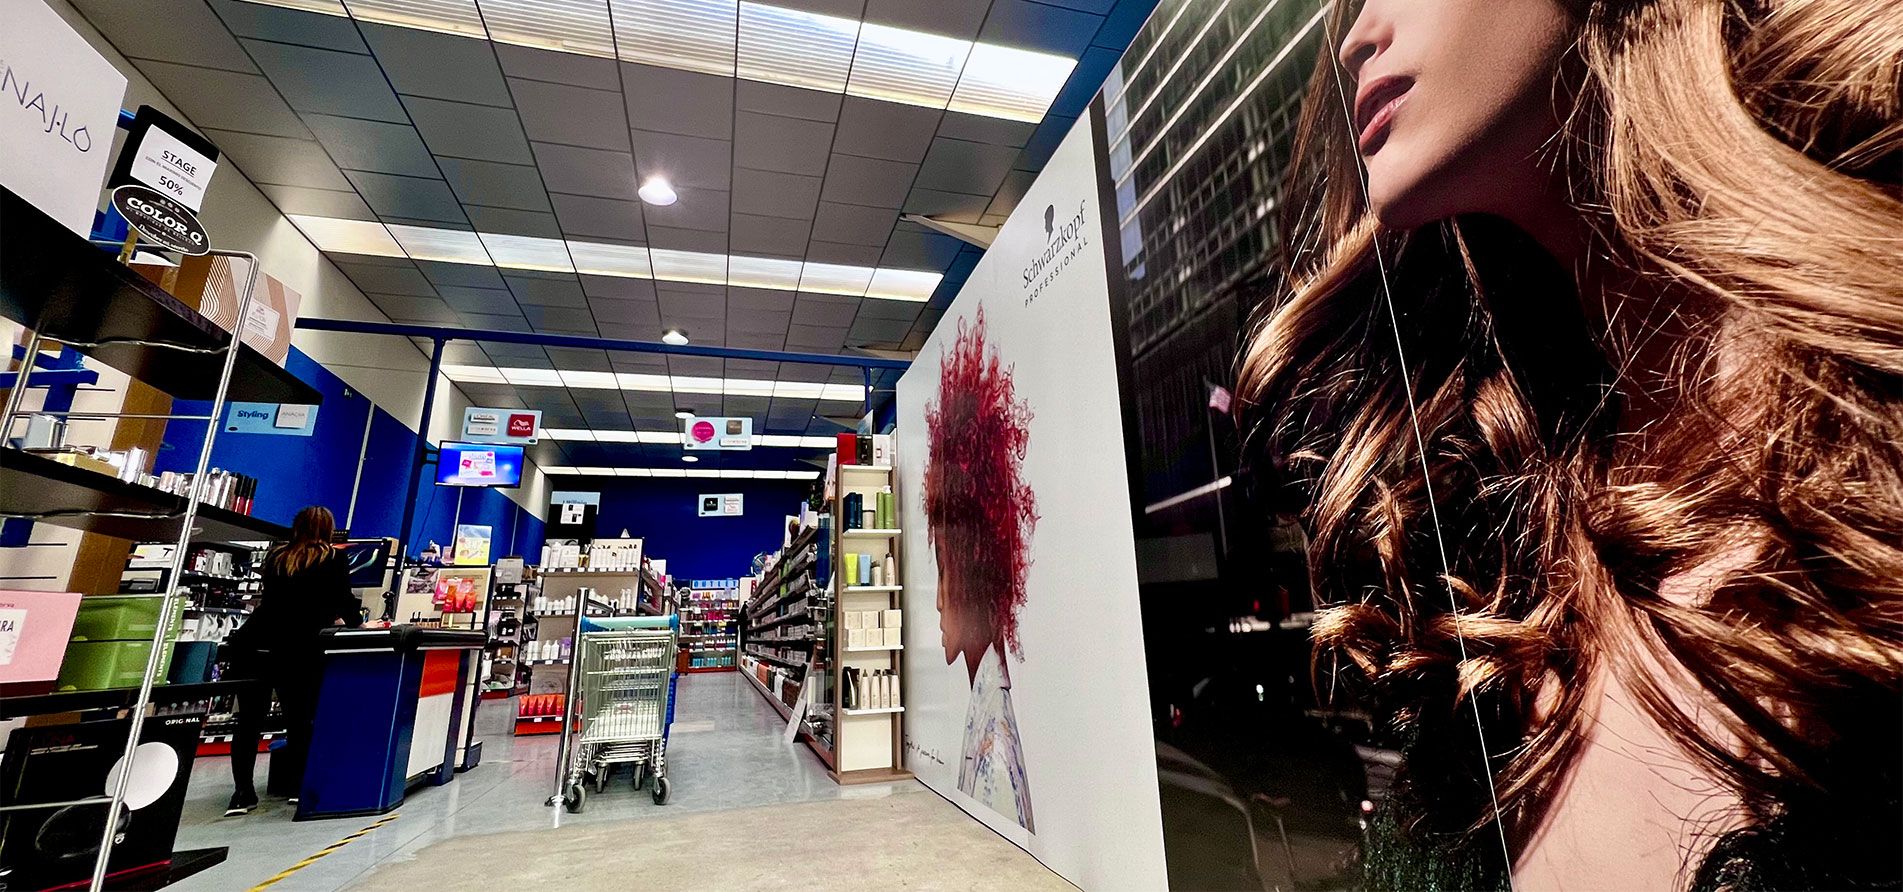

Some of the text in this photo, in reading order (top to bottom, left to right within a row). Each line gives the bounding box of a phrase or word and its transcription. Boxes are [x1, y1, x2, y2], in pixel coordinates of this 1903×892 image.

[162, 150, 197, 176] STAGE
[158, 175, 184, 196] 50%
[127, 197, 203, 246] COLOR Q
[1023, 199, 1086, 289] Schwarzkopf
[1025, 237, 1089, 308] PROFESSIONAL
[237, 410, 269, 420] Styling
[0, 620, 14, 632] RA
[167, 598, 179, 632] ELEMENTS
[157, 642, 169, 677] ELEMENTS
